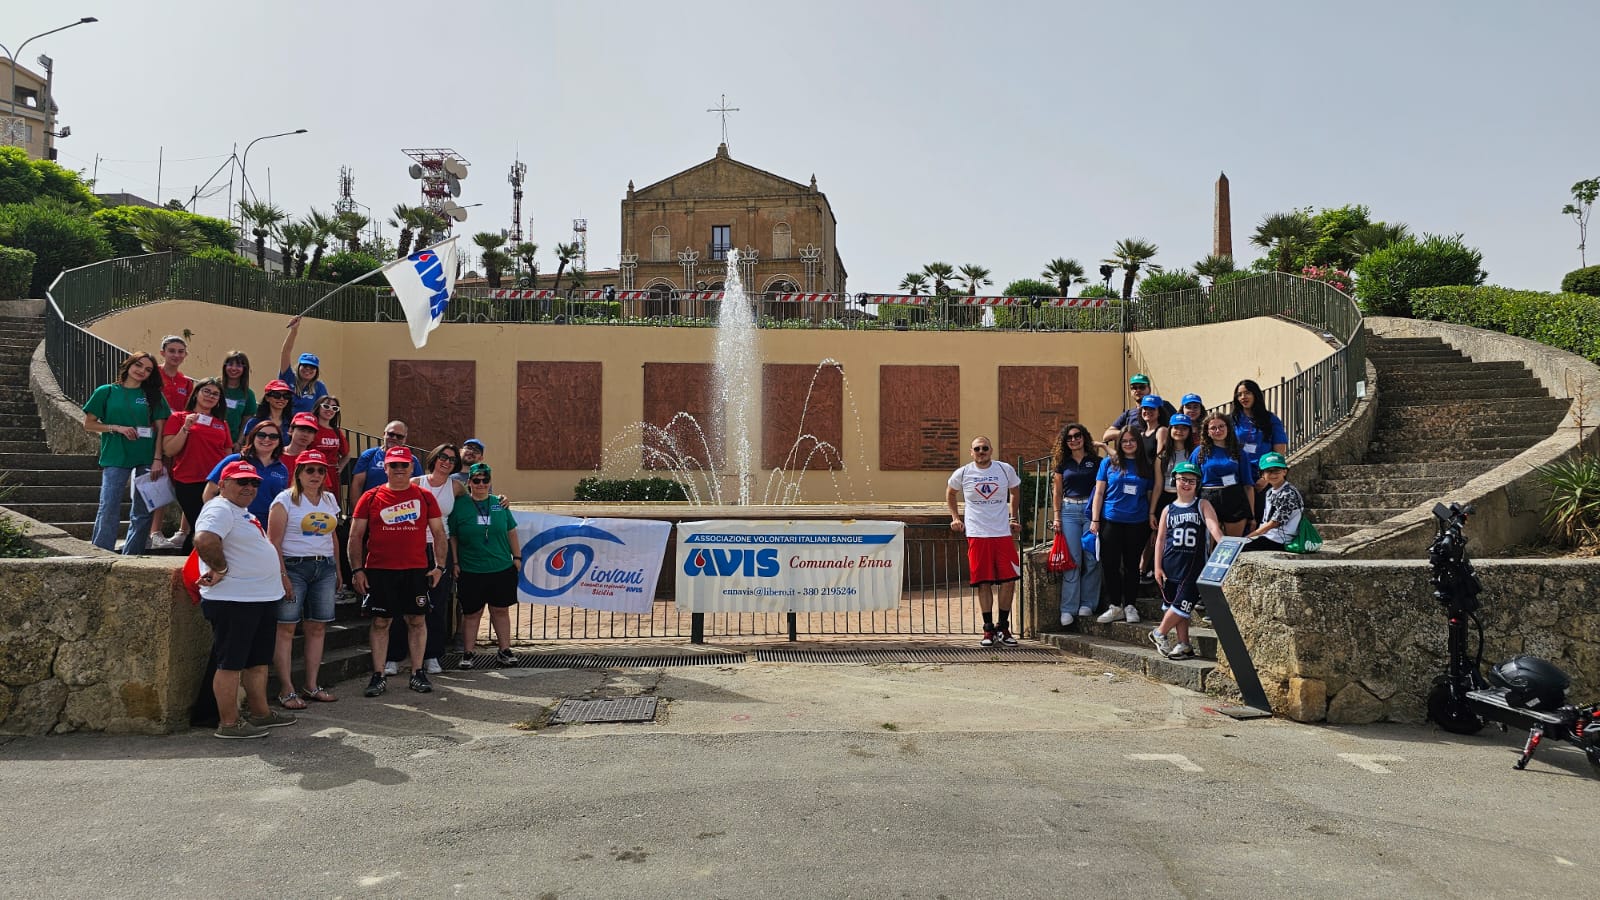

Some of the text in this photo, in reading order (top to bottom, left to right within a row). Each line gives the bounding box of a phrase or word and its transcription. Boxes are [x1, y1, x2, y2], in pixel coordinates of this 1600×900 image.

[394, 501, 416, 512] red
[694, 535, 752, 543] ASSOCIAZIONE
[753, 535, 797, 543] VOLONTARI
[1172, 528, 1197, 547] 96
[683, 548, 780, 577] AVIS
[789, 555, 893, 569] Comunale Enna
[592, 588, 614, 596] Sicilia
[722, 587, 796, 597] ennavis@libero.it
[802, 587, 819, 596] 380
[820, 587, 857, 596] 2195246
[1180, 600, 1193, 613] 96
